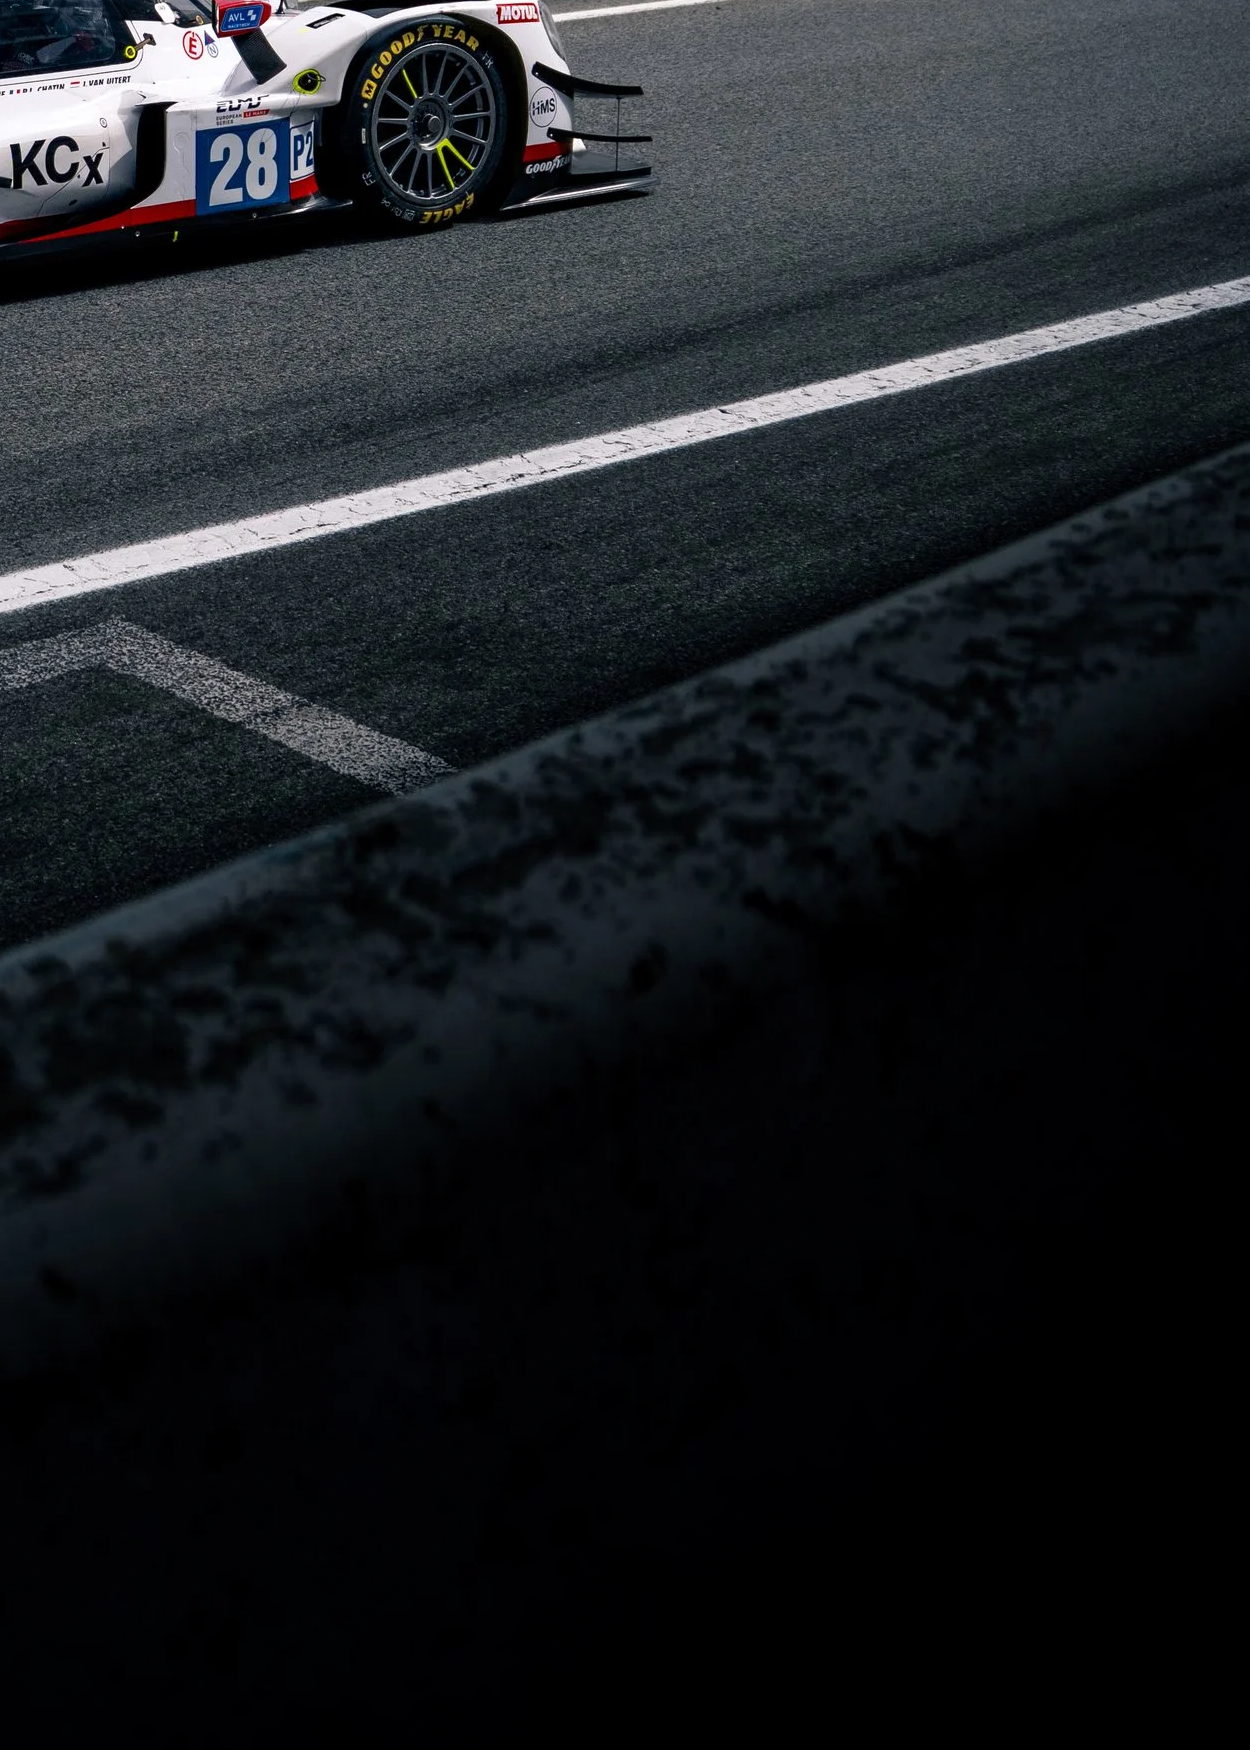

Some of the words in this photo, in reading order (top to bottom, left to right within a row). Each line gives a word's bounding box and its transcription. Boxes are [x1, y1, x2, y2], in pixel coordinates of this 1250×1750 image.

[228, 12, 245, 23] AVL
[500, 5, 538, 21] MOTUL
[106, 75, 132, 85] UITERT
[532, 97, 556, 117] HMS
[294, 131, 314, 171] P2
[209, 128, 278, 206] 28
[419, 192, 475, 224] EAGLE
